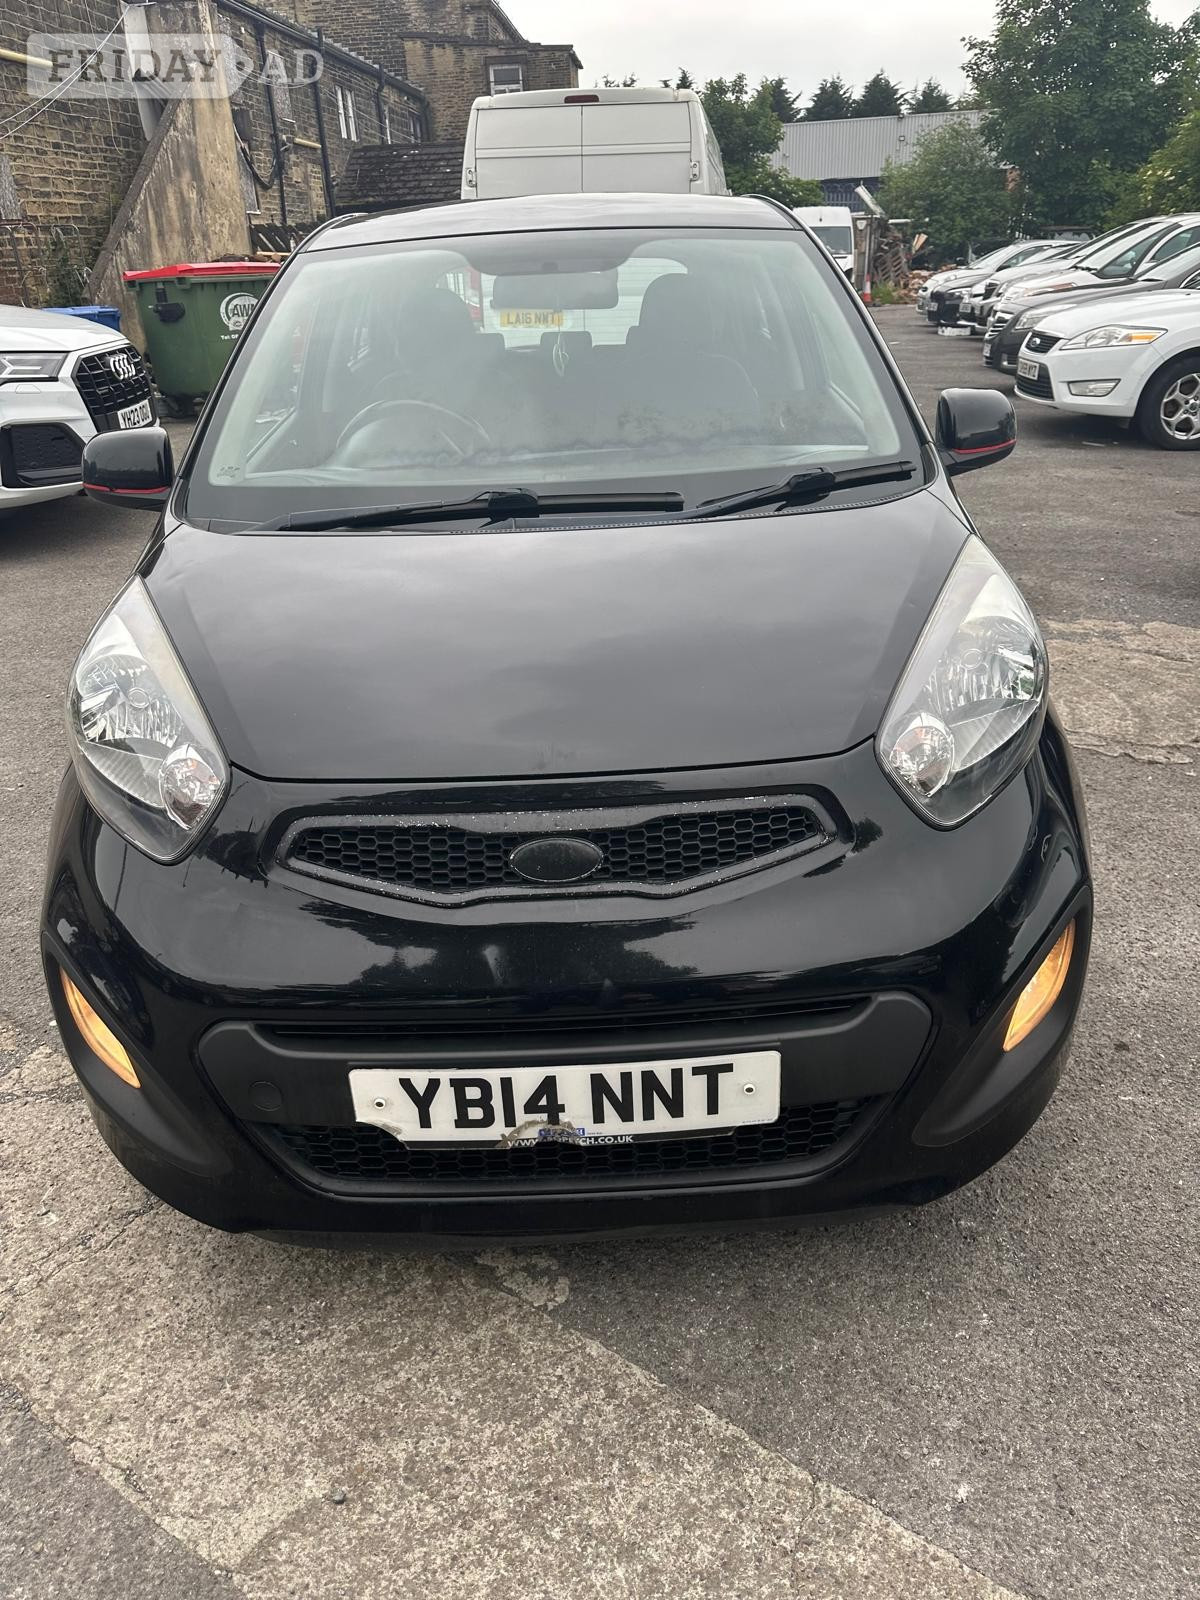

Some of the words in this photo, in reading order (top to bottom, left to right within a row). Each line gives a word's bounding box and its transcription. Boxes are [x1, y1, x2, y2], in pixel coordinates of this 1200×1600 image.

[121, 408, 140, 428] YH23
[400, 1075, 565, 1129] YB14
[590, 1063, 734, 1123] NNT
